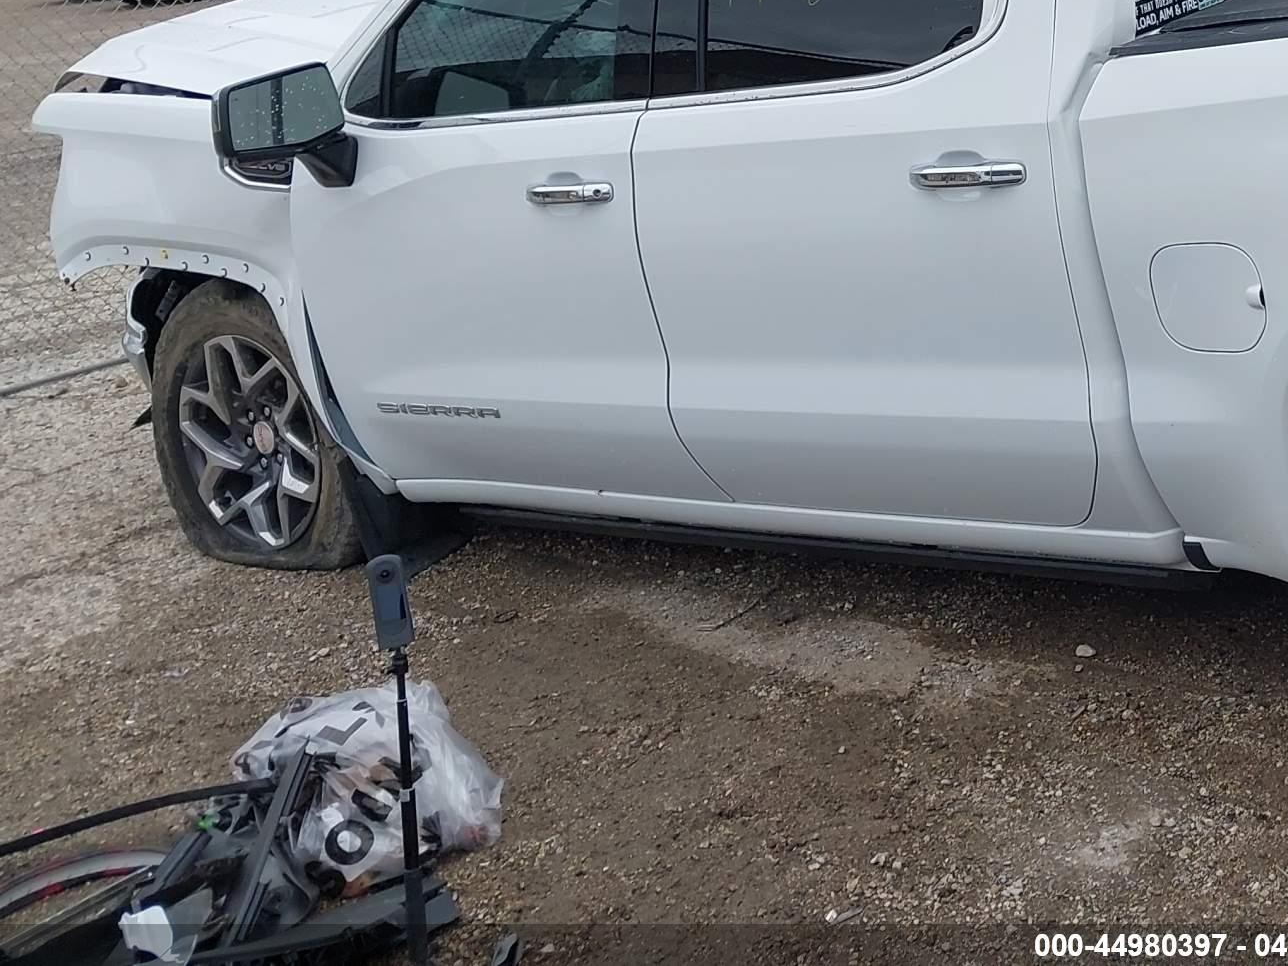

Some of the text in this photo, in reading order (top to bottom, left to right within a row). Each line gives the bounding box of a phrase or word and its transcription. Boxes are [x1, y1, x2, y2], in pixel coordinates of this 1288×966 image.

[1140, 0, 1155, 15] THAT
[1159, 5, 1174, 23] AIM
[1174, 3, 1182, 16] &
[377, 402, 501, 419] SIERRA
